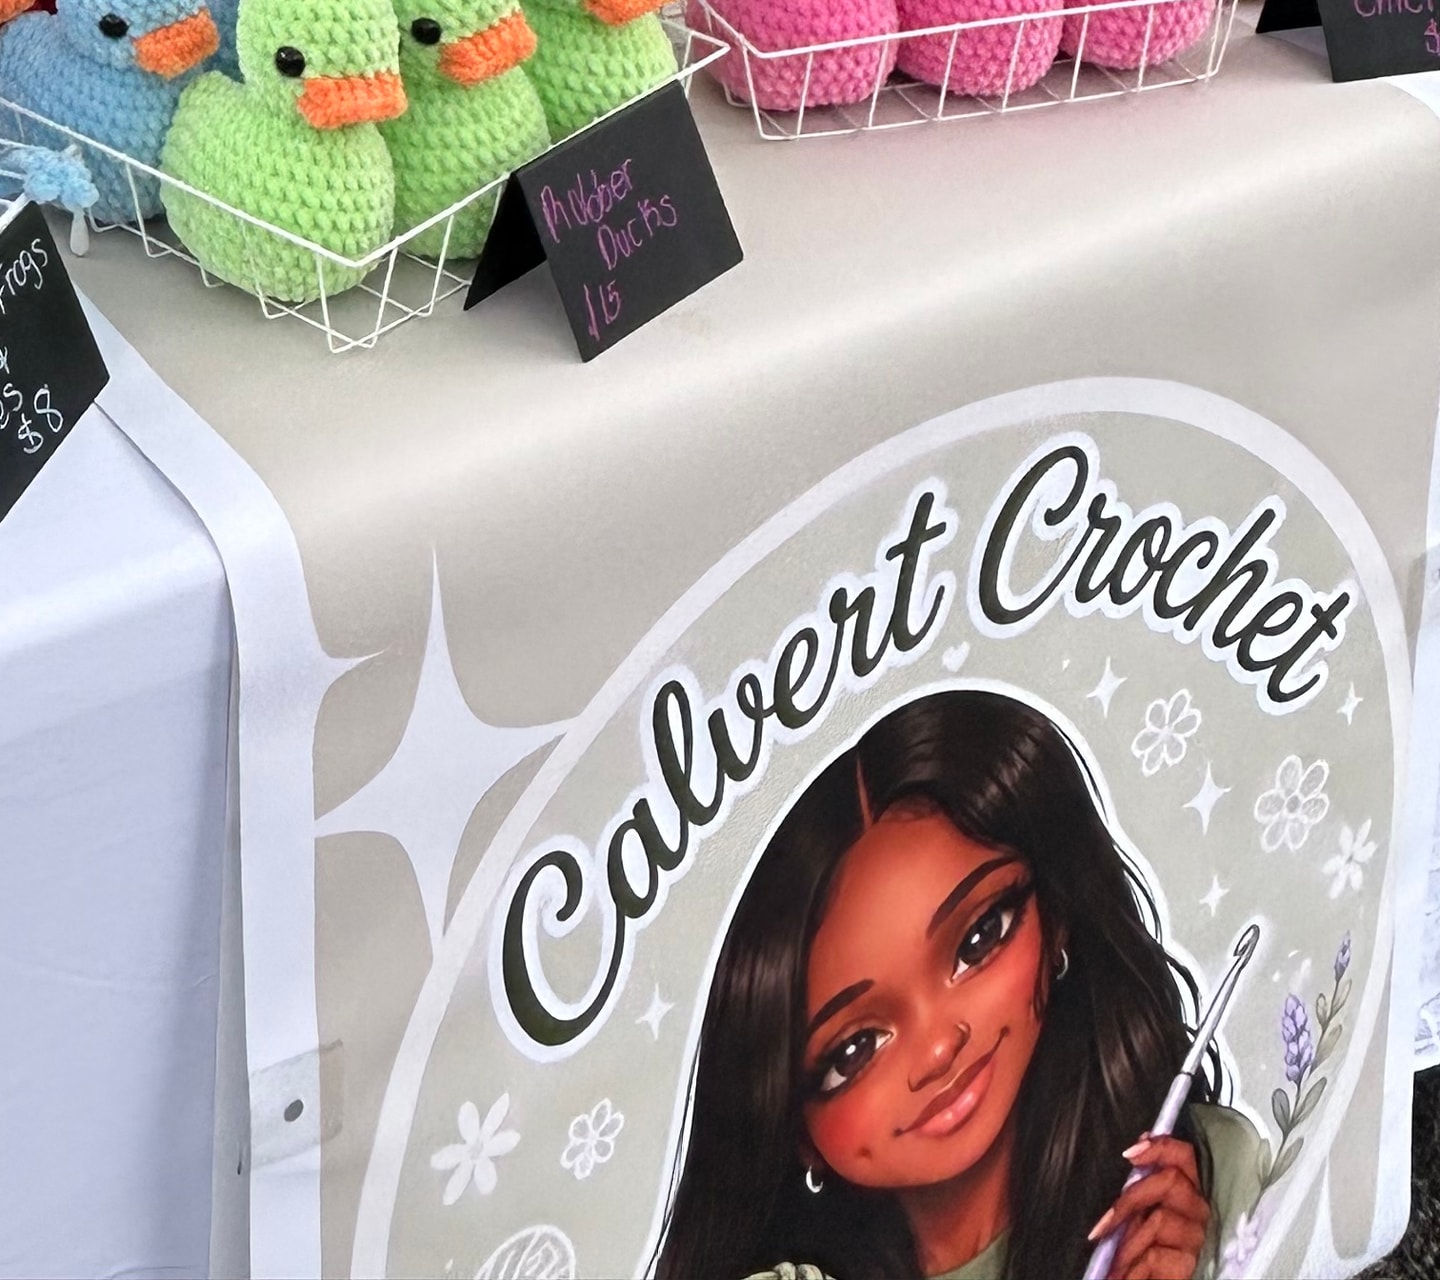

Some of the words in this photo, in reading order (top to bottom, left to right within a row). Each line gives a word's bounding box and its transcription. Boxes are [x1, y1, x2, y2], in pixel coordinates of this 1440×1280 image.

[17, 383, 63, 454] $8
[501, 489, 947, 1048] Calvert
[978, 444, 1350, 703] Crochet
